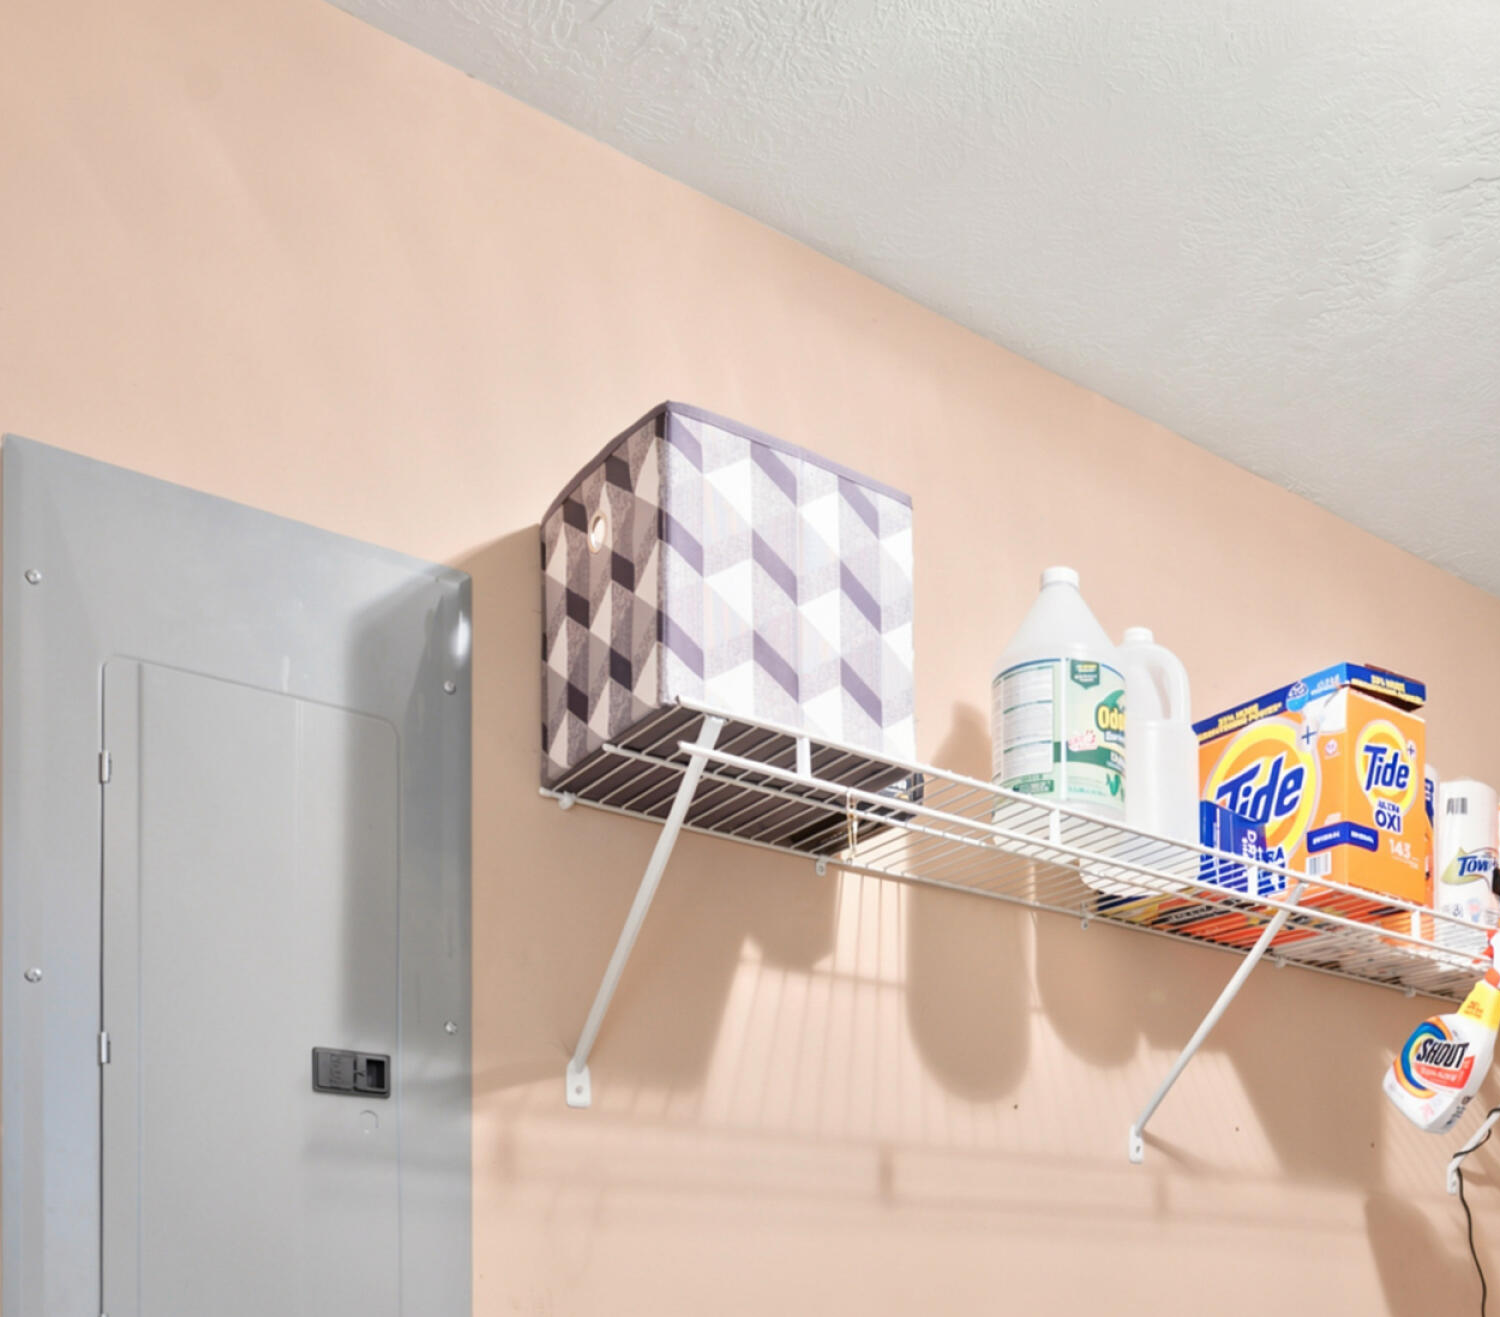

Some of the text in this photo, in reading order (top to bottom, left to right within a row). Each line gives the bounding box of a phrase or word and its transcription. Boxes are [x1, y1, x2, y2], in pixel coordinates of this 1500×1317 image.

[1364, 745, 1410, 791] Tide
[1216, 755, 1304, 823] Tide
[1375, 809, 1400, 833] OXI
[1416, 1038, 1470, 1069] SHOUT
